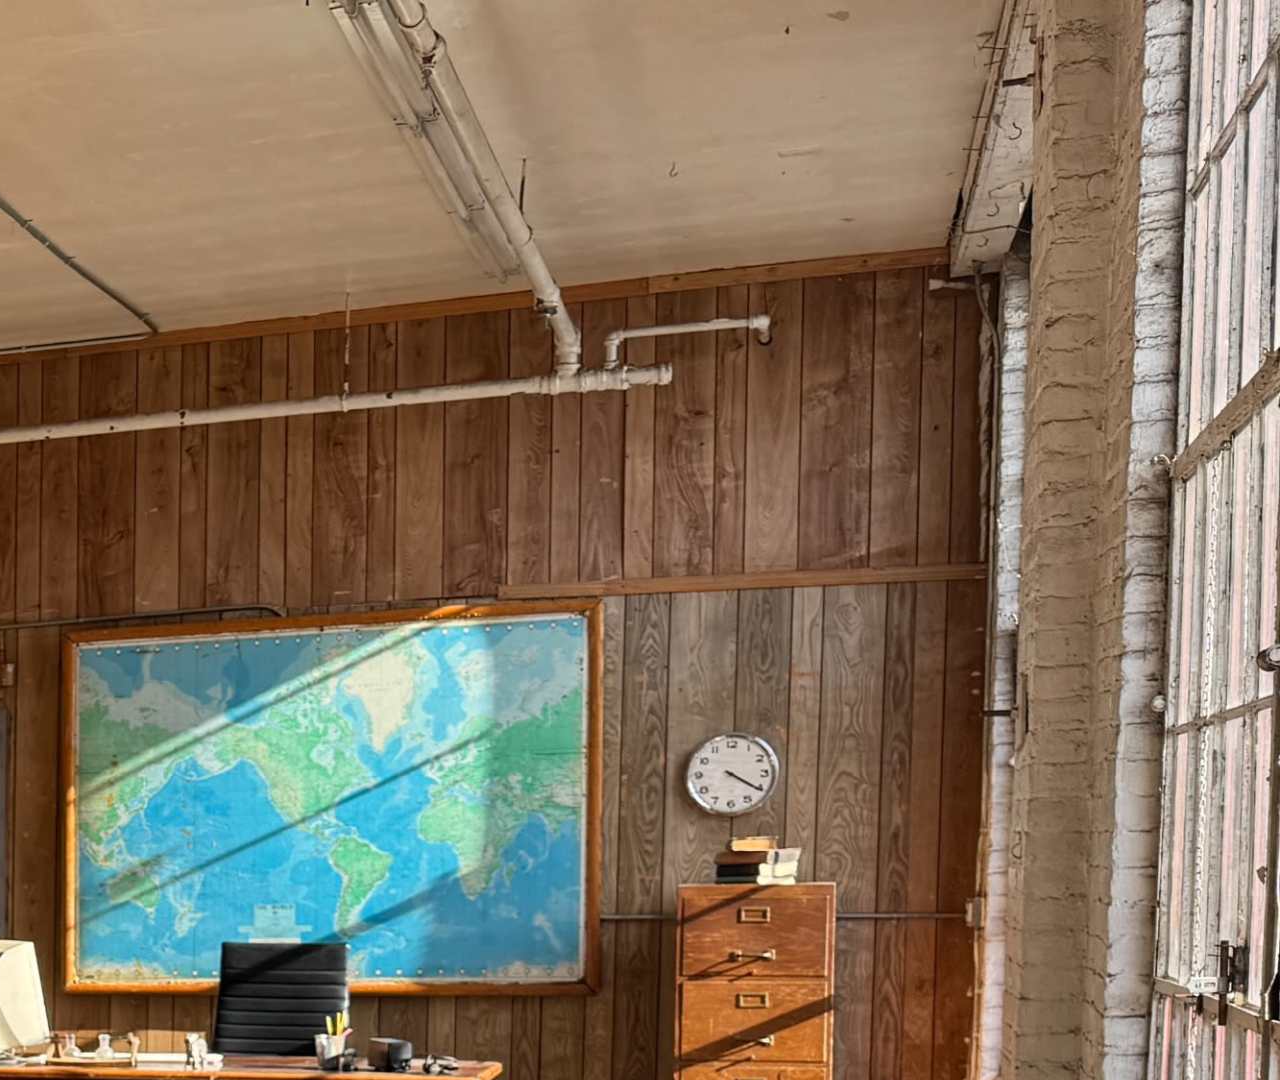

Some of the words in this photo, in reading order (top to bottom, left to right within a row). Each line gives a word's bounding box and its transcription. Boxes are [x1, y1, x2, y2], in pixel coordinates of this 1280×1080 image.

[726, 741, 738, 749] 12
[711, 746, 719, 754] 11
[700, 757, 709, 765] 10
[755, 754, 765, 763] 2
[694, 771, 703, 779] 9
[760, 769, 769, 778] 3
[710, 796, 719, 804] 7
[743, 795, 752, 803] 5
[726, 800, 735, 809] 6
